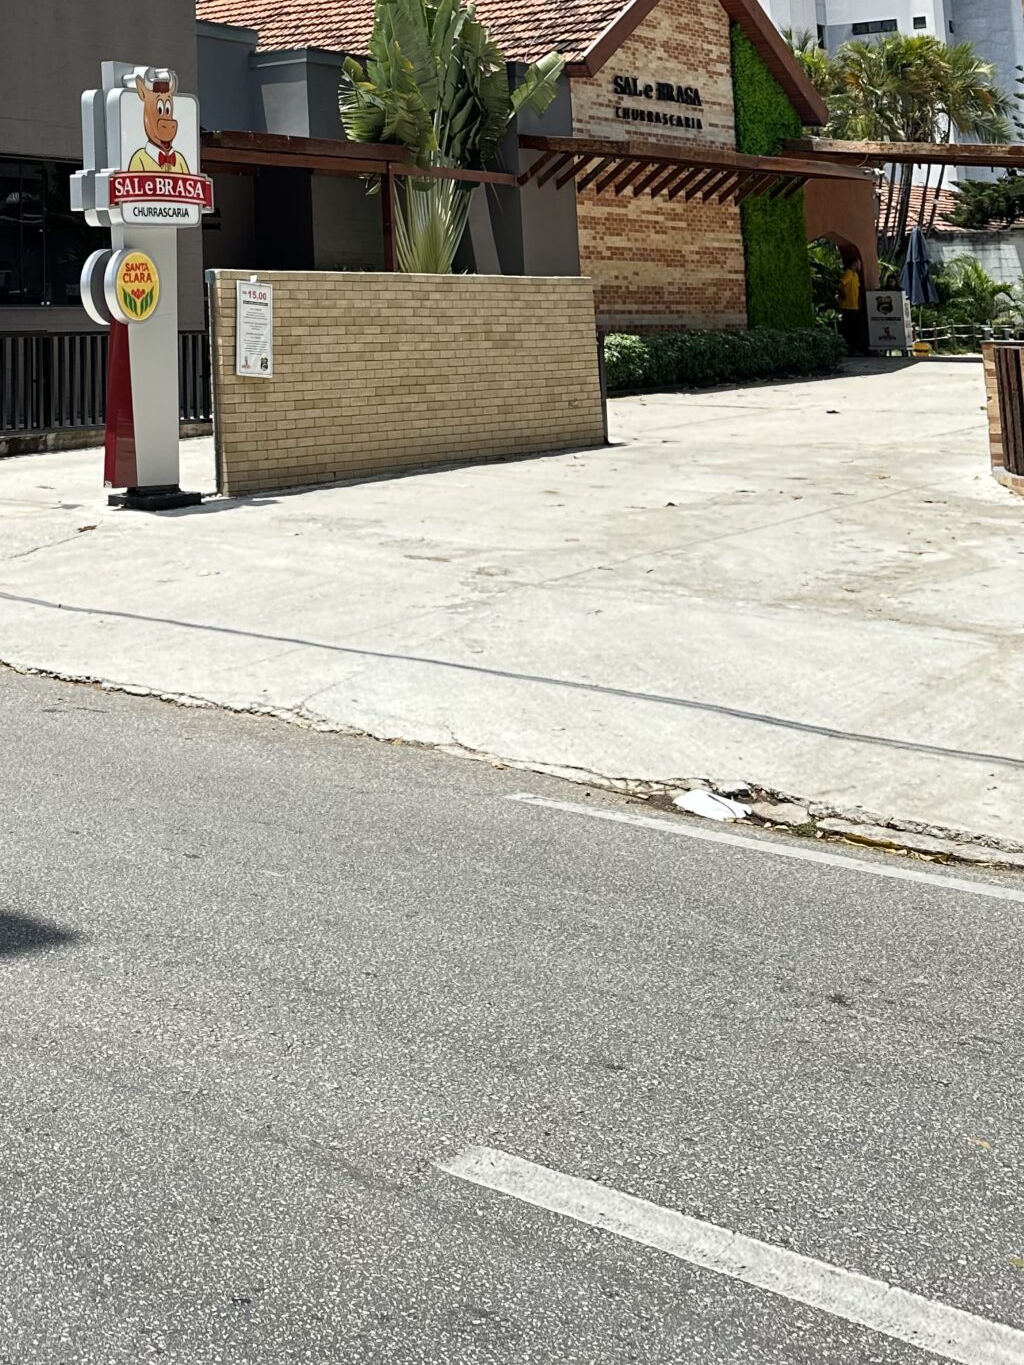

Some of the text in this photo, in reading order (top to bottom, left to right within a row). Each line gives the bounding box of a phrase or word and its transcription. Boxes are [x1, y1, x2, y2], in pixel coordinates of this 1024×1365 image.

[614, 75, 702, 107] SAL e BRASA
[615, 107, 703, 130] CHURRASCARIA
[115, 177, 204, 198] SAL e BRASA
[133, 207, 190, 218] CHURRASCARIA
[125, 263, 149, 273] SANTA
[123, 273, 153, 283] CLARA
[248, 290, 267, 301] 15,00
